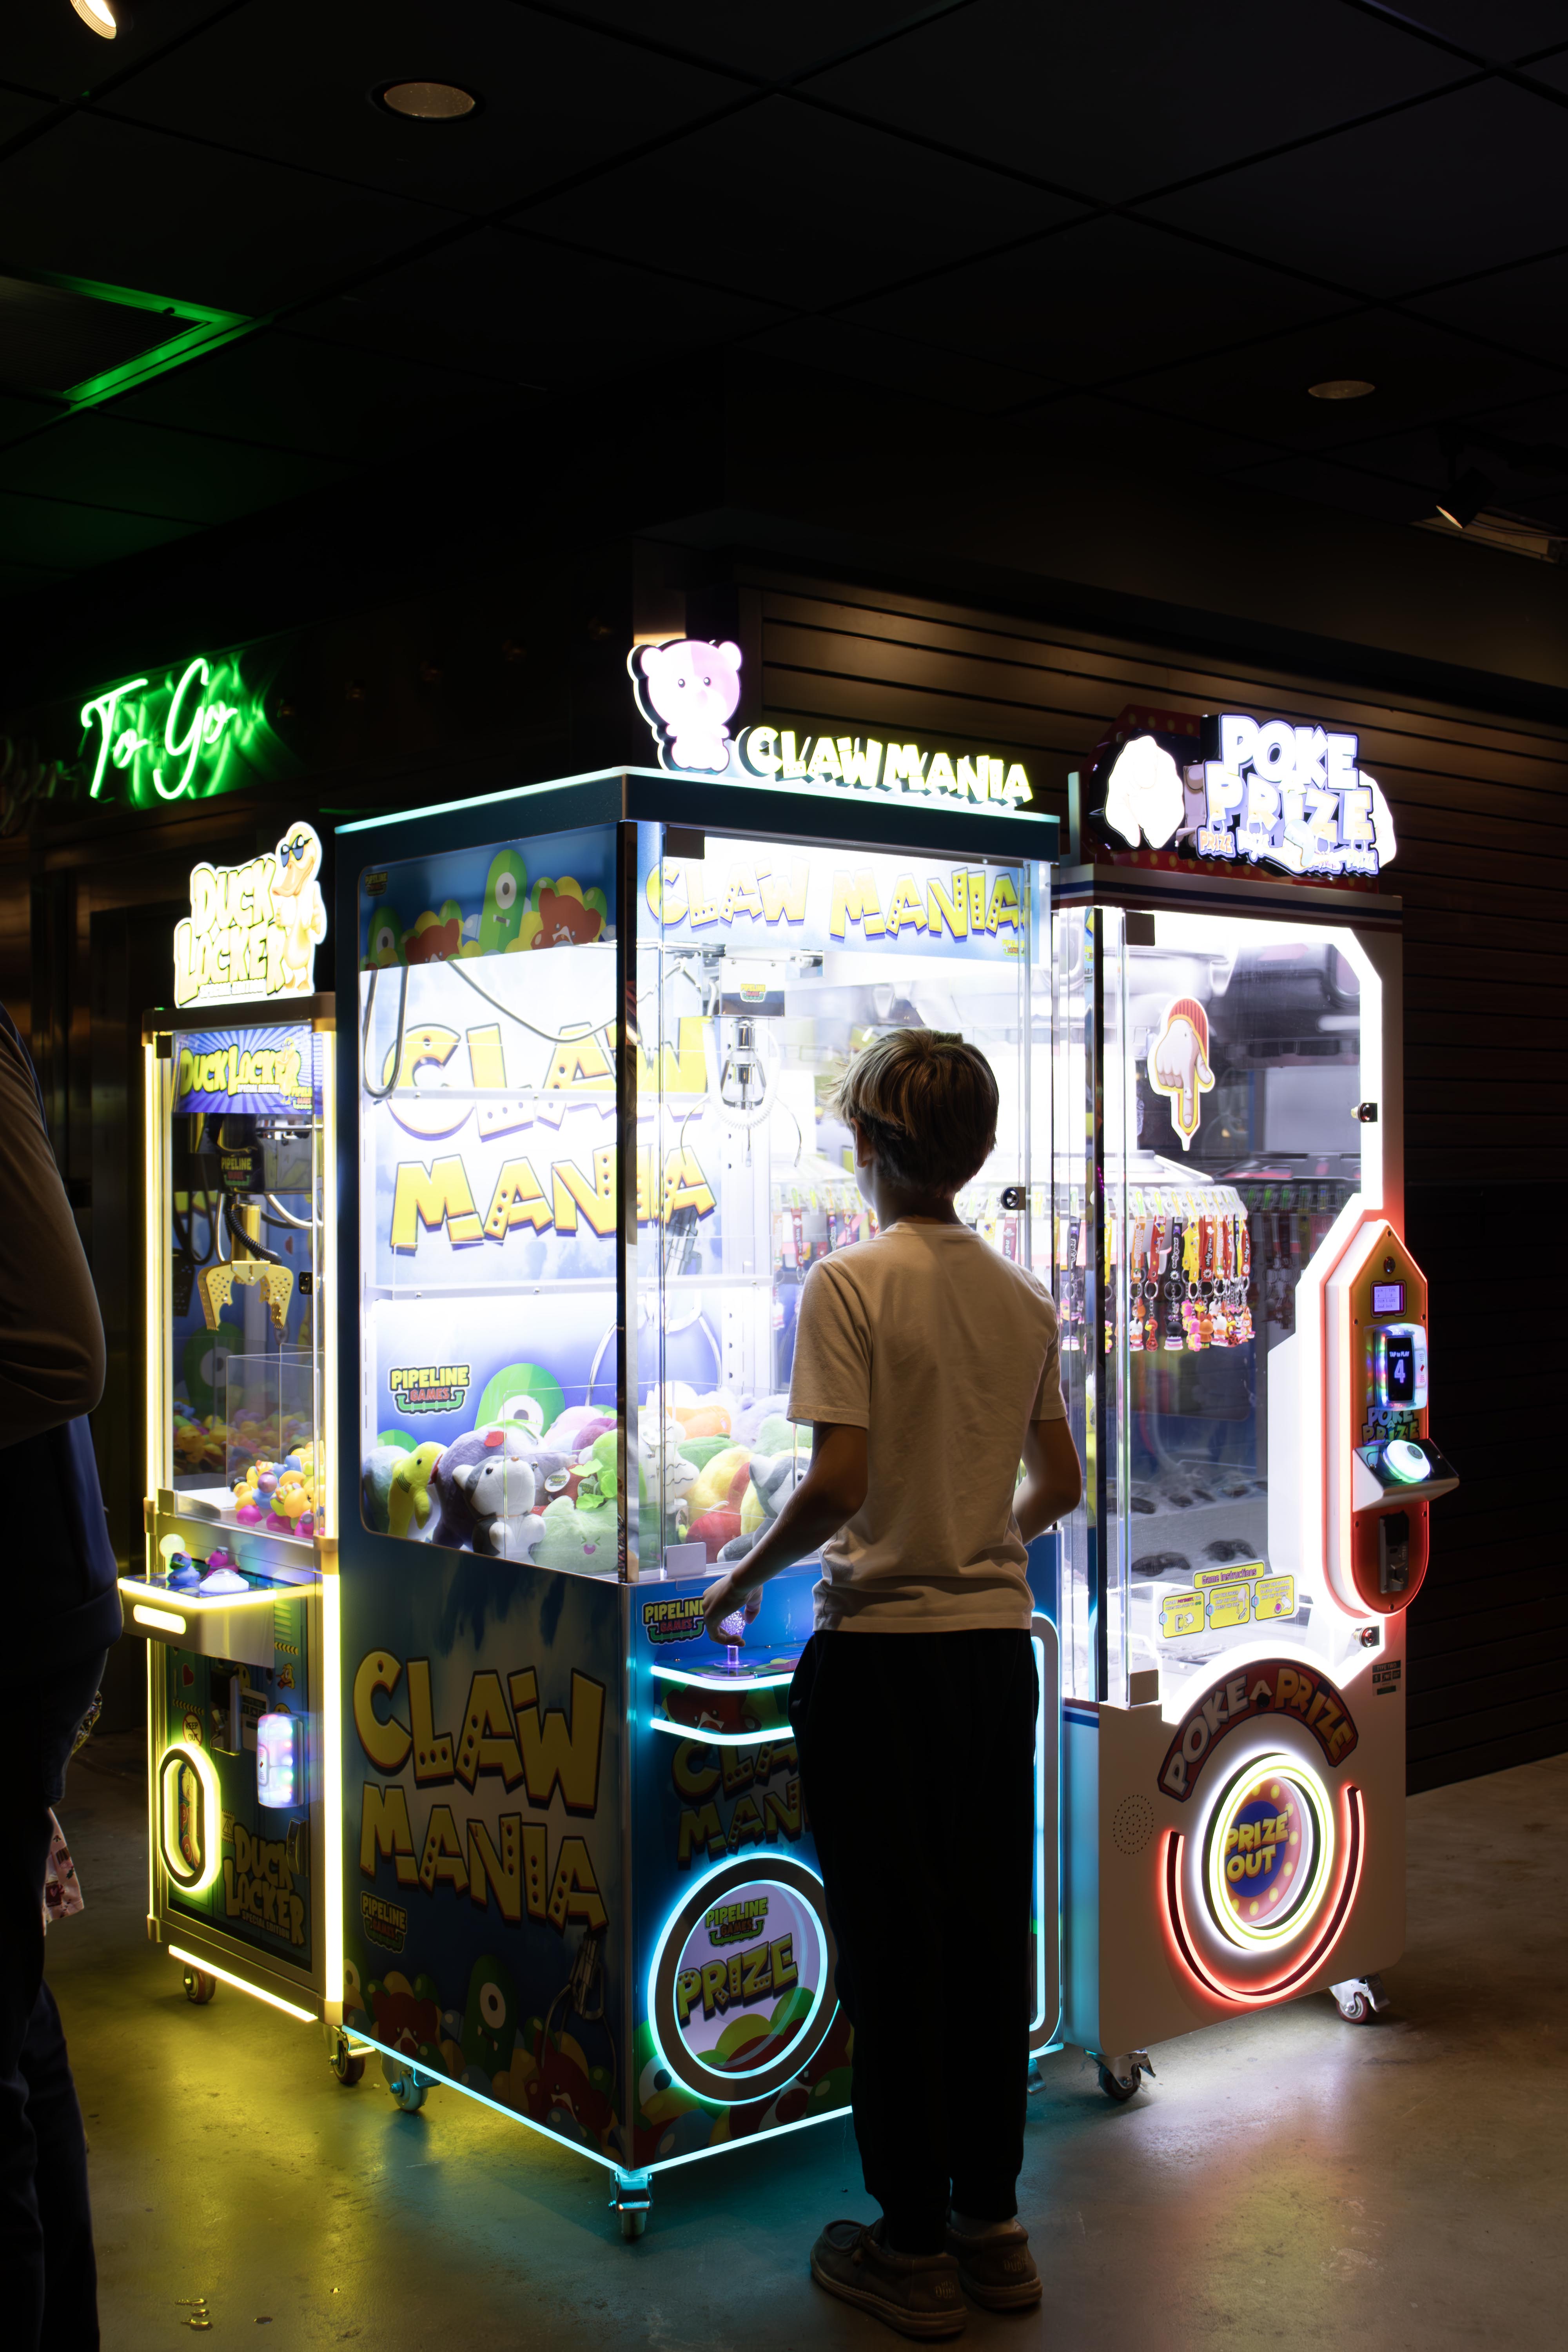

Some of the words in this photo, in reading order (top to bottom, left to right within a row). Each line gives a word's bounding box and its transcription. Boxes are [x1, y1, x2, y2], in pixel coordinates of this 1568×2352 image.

[80, 678, 148, 799] To
[152, 657, 238, 800] Go
[1222, 715, 1357, 790] POKE
[1207, 763, 1373, 844] PRIZE
[1200, 830, 1233, 853] PRIZE
[193, 857, 276, 937] DUCK
[646, 855, 811, 931] CLAW
[830, 867, 1024, 939] MANIA
[178, 922, 287, 1006] LOCKER
[180, 1047, 228, 1097] DUCK
[383, 1022, 708, 1142] CLAW
[221, 1157, 252, 1171] PIPELINE
[389, 1143, 717, 1256] MANIA
[1134, 1229, 1143, 1261] STRIVE
[390, 1366, 469, 1389] PIPELINE
[409, 1388, 450, 1401] GAMES
[1394, 1359, 1406, 1383] 4
[1362, 1420, 1419, 1443] PRIZE
[1368, 1407, 1414, 1427] POKE
[1386, 1420, 1396, 1429] A
[1201, 1574, 1220, 1585] Game
[1220, 1567, 1257, 1583] Instructions
[660, 1617, 693, 1633] GAMES
[353, 1648, 606, 1814] CLAW
[1163, 1674, 1249, 1795] POKE
[1249, 1681, 1274, 1702] A
[1273, 1667, 1354, 1759] PRIZE
[672, 1738, 799, 1797] CLA
[677, 1776, 810, 1863] MAN
[1225, 1810, 1290, 1857] PRIZE
[233, 1822, 294, 1890] DUCK
[359, 1781, 609, 1931] MANIA
[1227, 1846, 1278, 1882] OUT
[223, 1856, 306, 1945] LOCKER
[362, 1895, 407, 1929] PIPELINE
[706, 1896, 768, 1929] PIPELINE
[241, 1910, 265, 1930] SPECIAL
[266, 1920, 290, 1940] EDITION
[719, 1918, 753, 1936] GAMES
[676, 1933, 798, 2021] PRIZE
